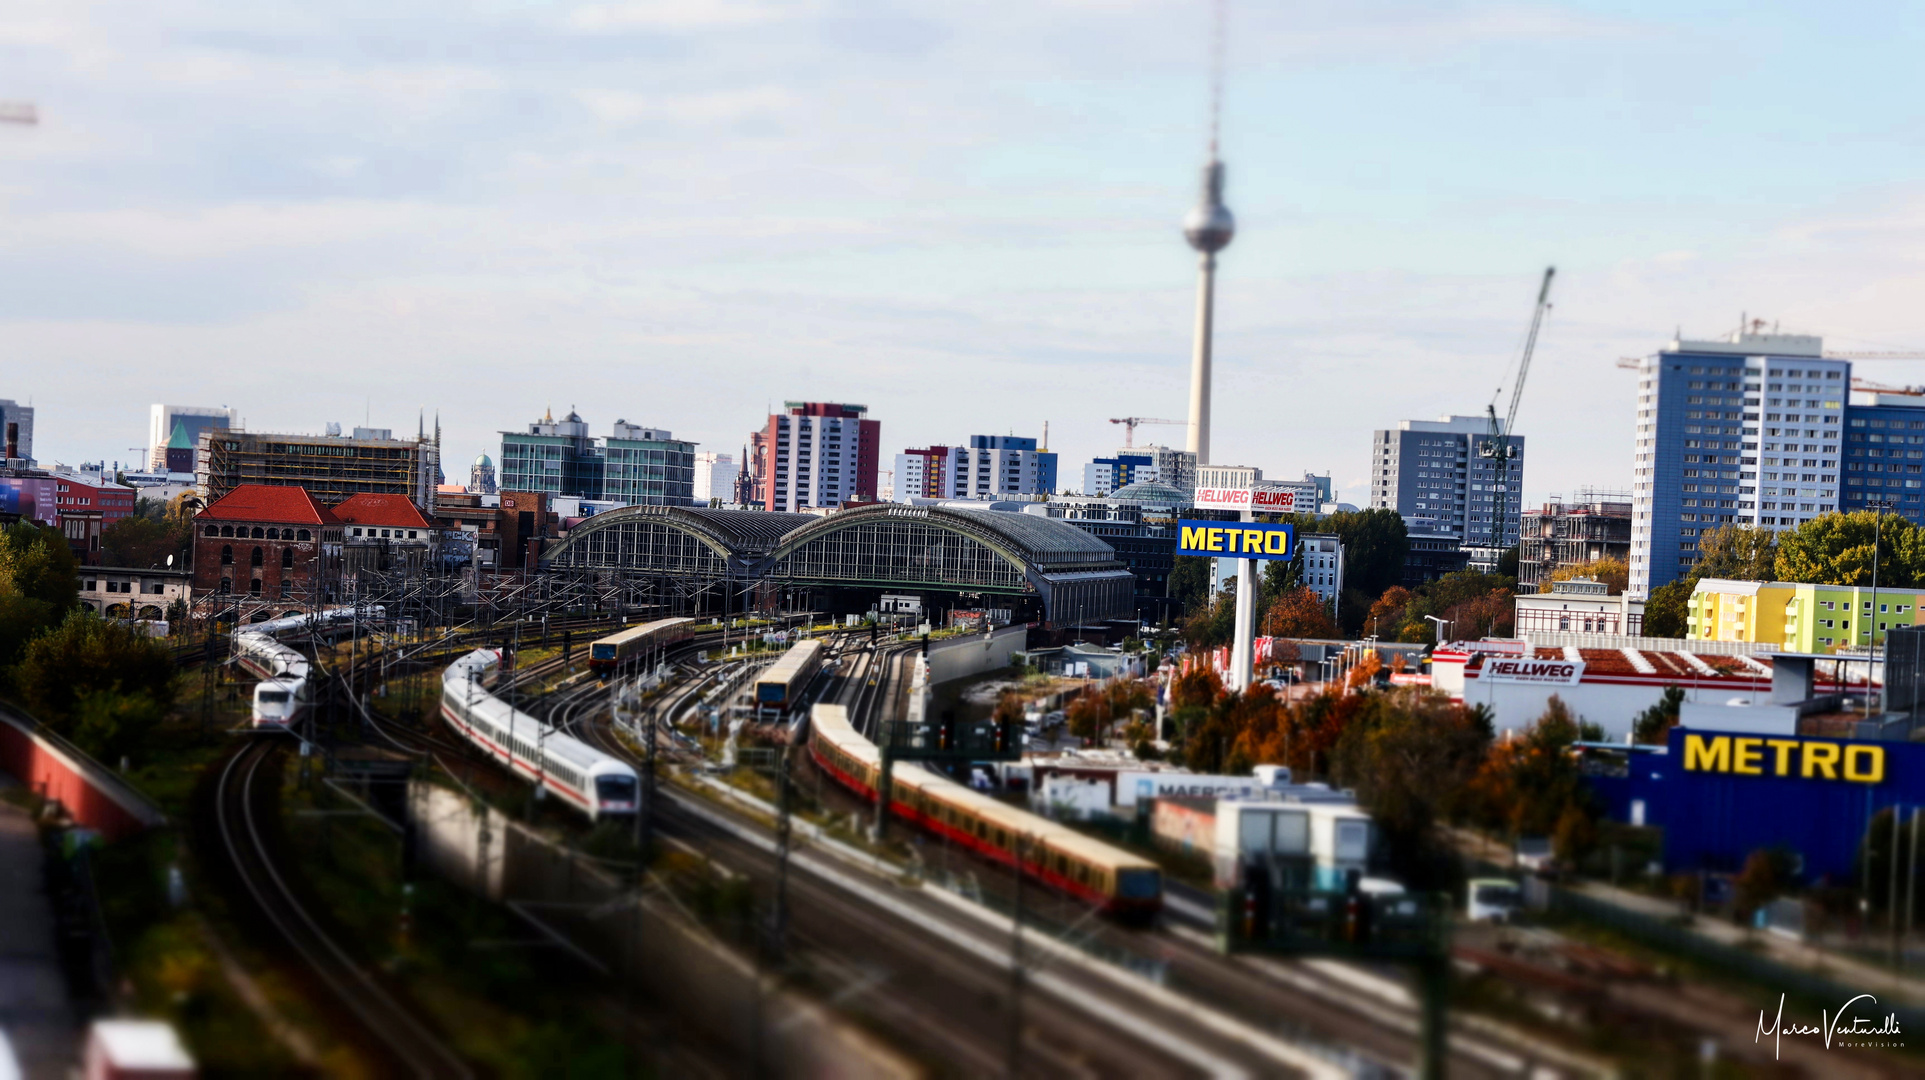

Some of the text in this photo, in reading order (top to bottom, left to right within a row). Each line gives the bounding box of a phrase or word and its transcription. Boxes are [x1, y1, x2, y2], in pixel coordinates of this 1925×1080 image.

[1197, 489, 1249, 503] HELLWEG
[1252, 491, 1294, 506] HELLWEG
[1181, 526, 1287, 555] METRO
[1489, 662, 1575, 677] HELLWEG
[1684, 734, 1884, 782] METRO
